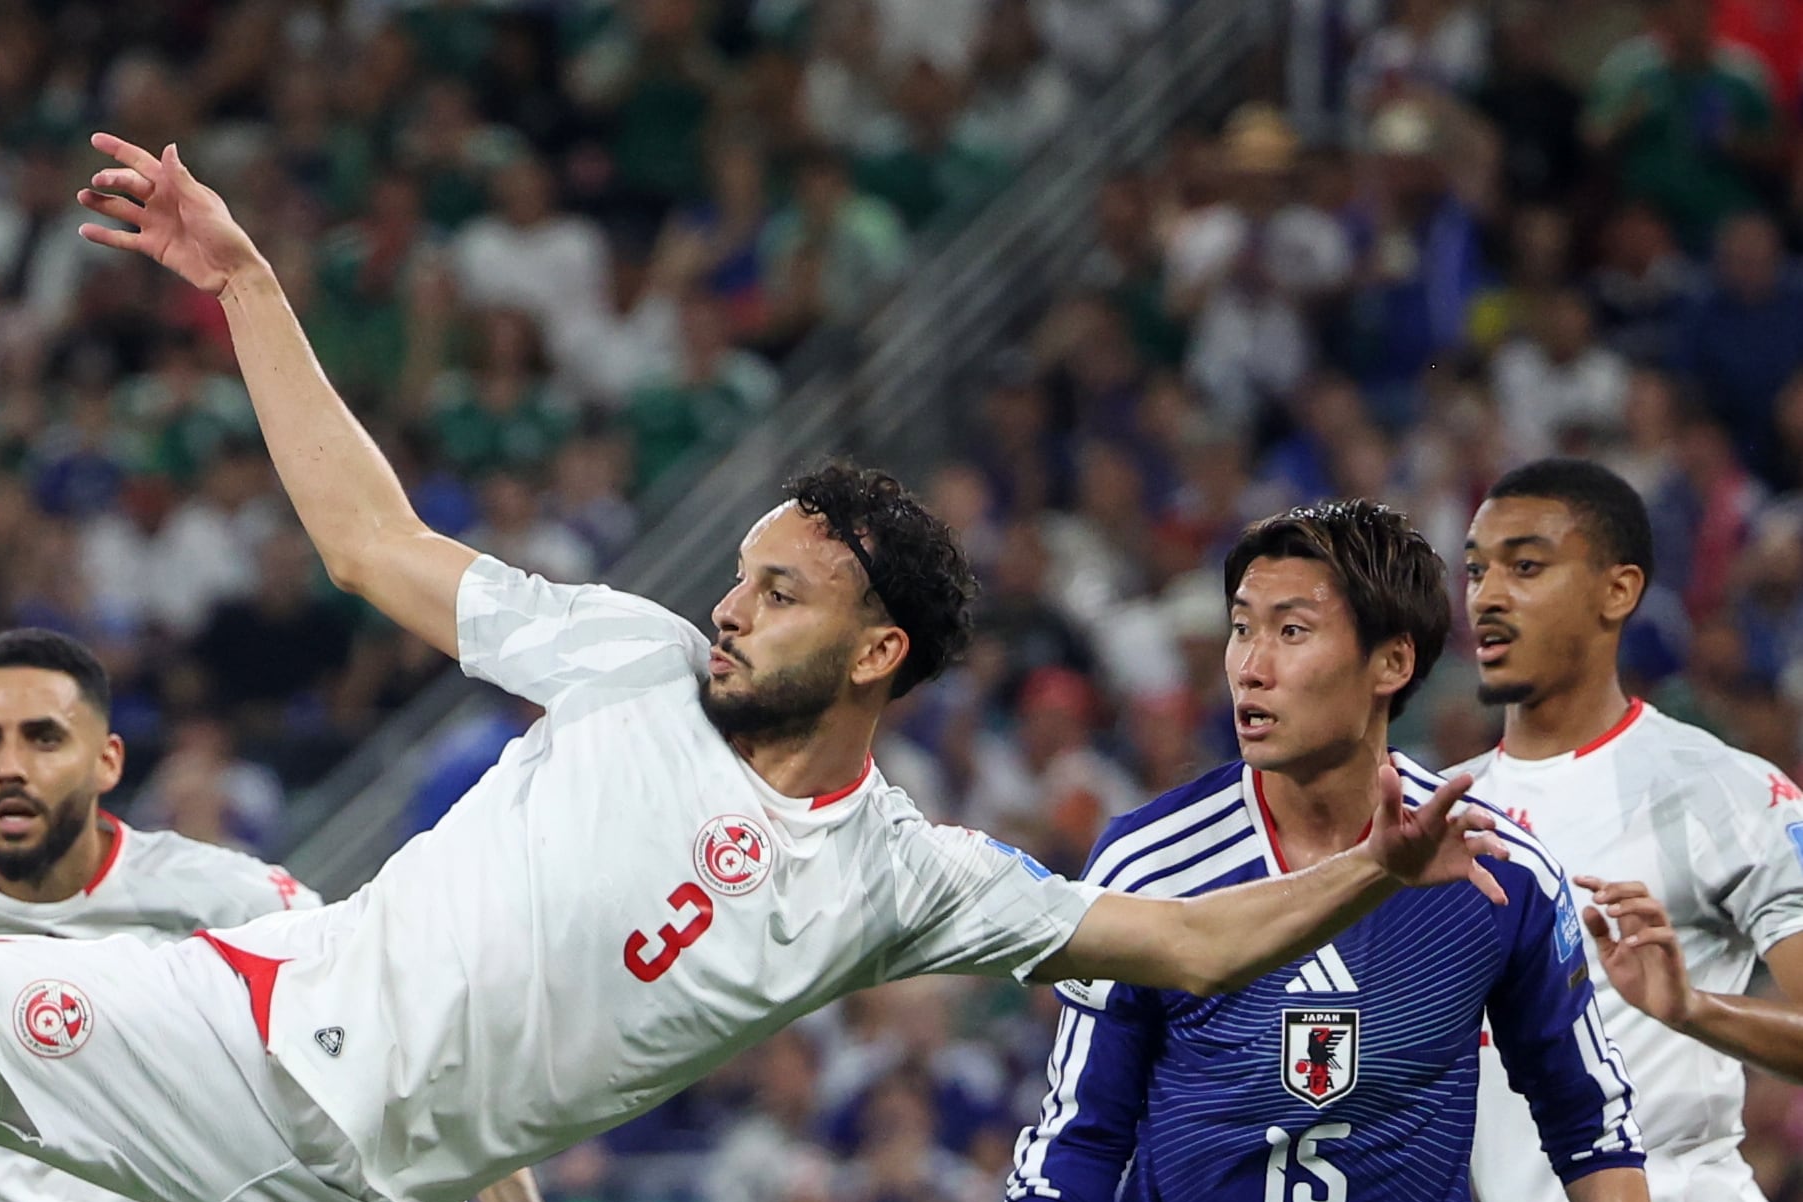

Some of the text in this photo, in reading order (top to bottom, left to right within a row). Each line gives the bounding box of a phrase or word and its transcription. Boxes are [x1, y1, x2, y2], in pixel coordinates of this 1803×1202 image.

[624, 881, 714, 983] 3
[1301, 1013, 1341, 1023] JAPAN
[1302, 1074, 1335, 1090] JFA
